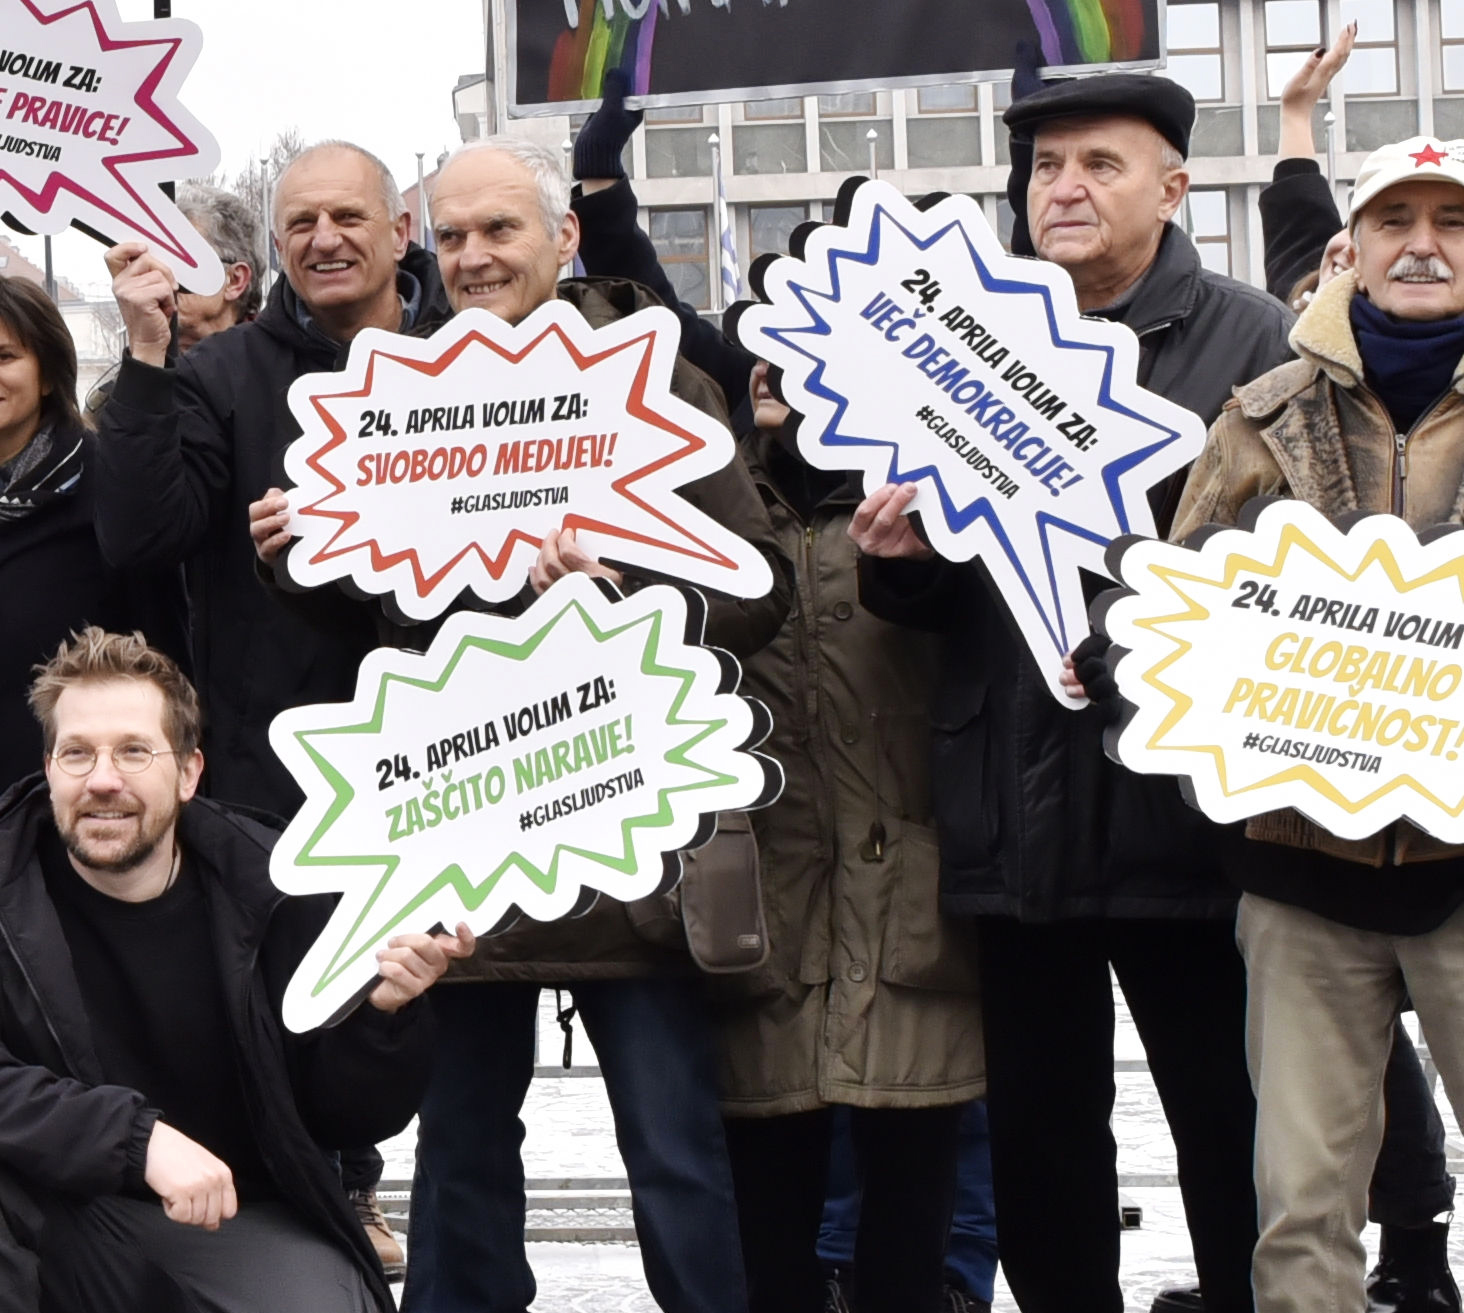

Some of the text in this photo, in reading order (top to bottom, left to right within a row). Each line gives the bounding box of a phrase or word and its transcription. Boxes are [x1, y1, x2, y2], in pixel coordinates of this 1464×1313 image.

[62, 66, 102, 93] ZA:
[6, 92, 131, 146] PRAVICE!
[900, 269, 1098, 452] 24. APRILA VOLIM ZA:
[358, 393, 588, 438] 24. APRILA VOLIM ZA:
[859, 291, 1084, 497] VEČ DEMOKRACIJE!
[356, 432, 618, 487] SVOBODO MEDIJEV!
[915, 405, 1020, 500] #GLASLJUDSTVA
[451, 486, 568, 514] #GLASLJUDSTVA
[1231, 580, 1280, 616] 24.
[1288, 594, 1379, 633] APRILA
[1265, 632, 1463, 701] GLOBALNO
[376, 675, 616, 791] 24. APRILA VOLIM ZA:
[1243, 732, 1382, 774] #GLASLJUDSTVA
[385, 714, 635, 843] ZAŠČITO NARAVE!
[519, 768, 644, 832] #GLASLJUDSTVA
